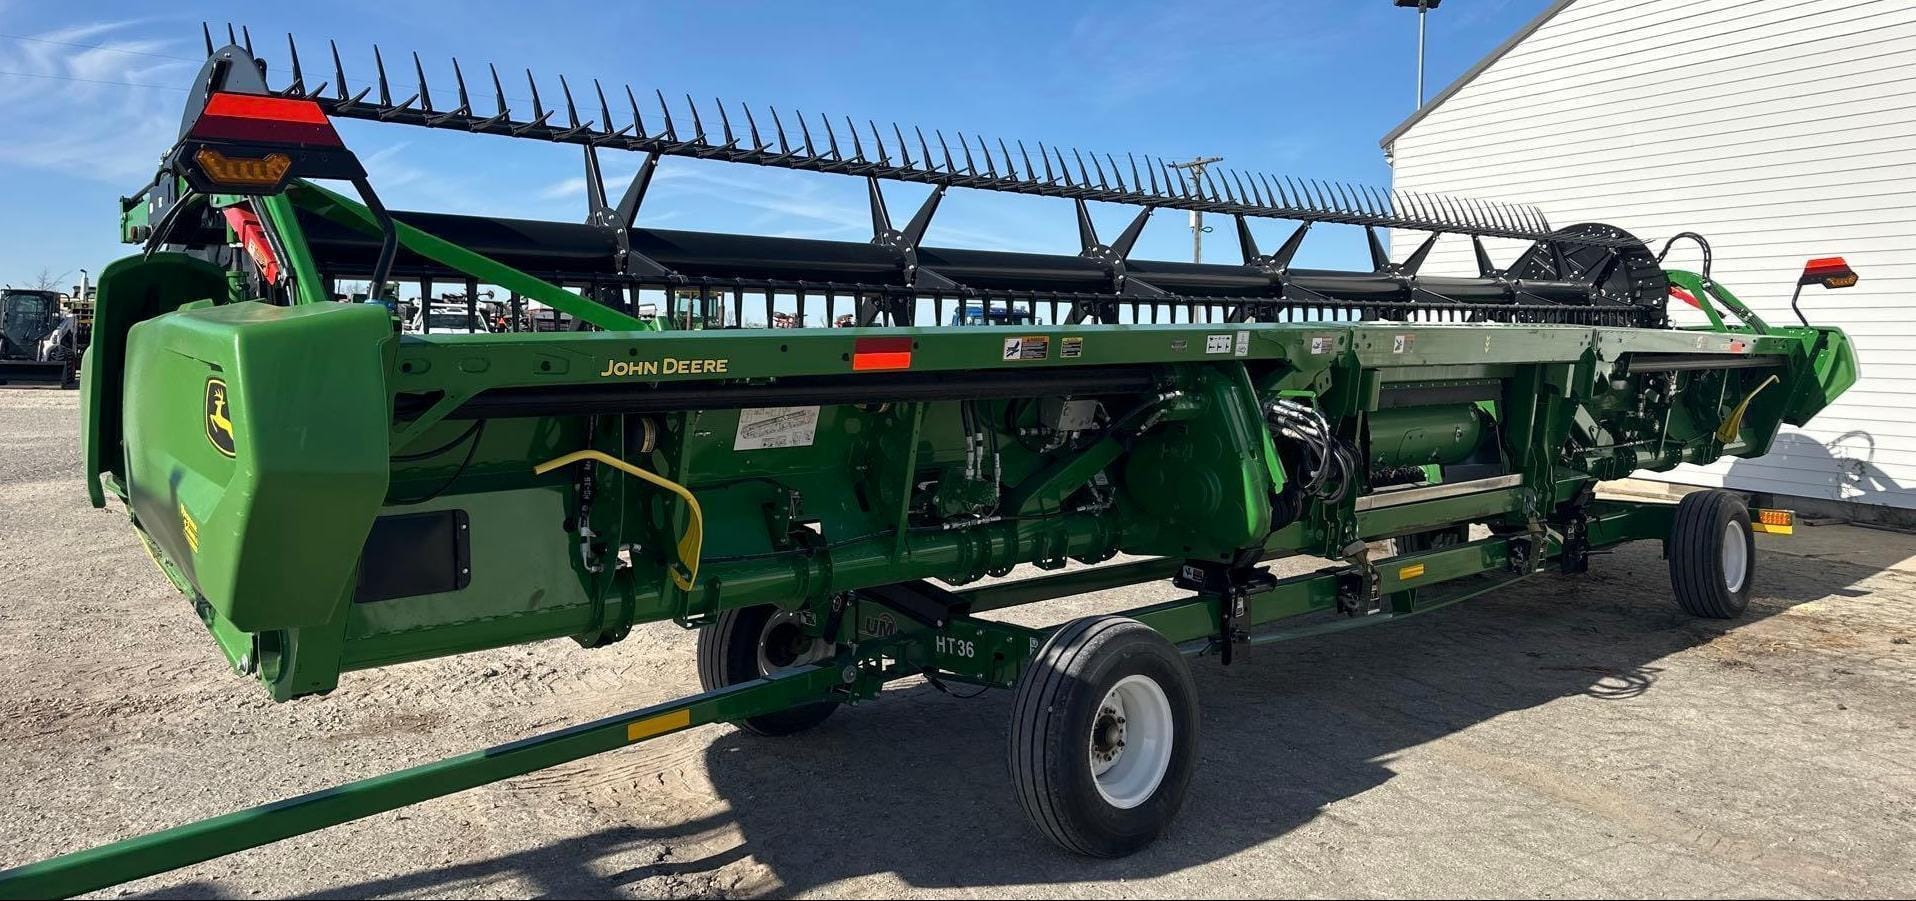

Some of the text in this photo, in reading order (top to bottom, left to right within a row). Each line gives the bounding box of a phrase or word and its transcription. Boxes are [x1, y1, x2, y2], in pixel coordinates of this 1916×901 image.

[601, 358, 728, 377] JOHN DEERE
[935, 635, 975, 659] HT36
